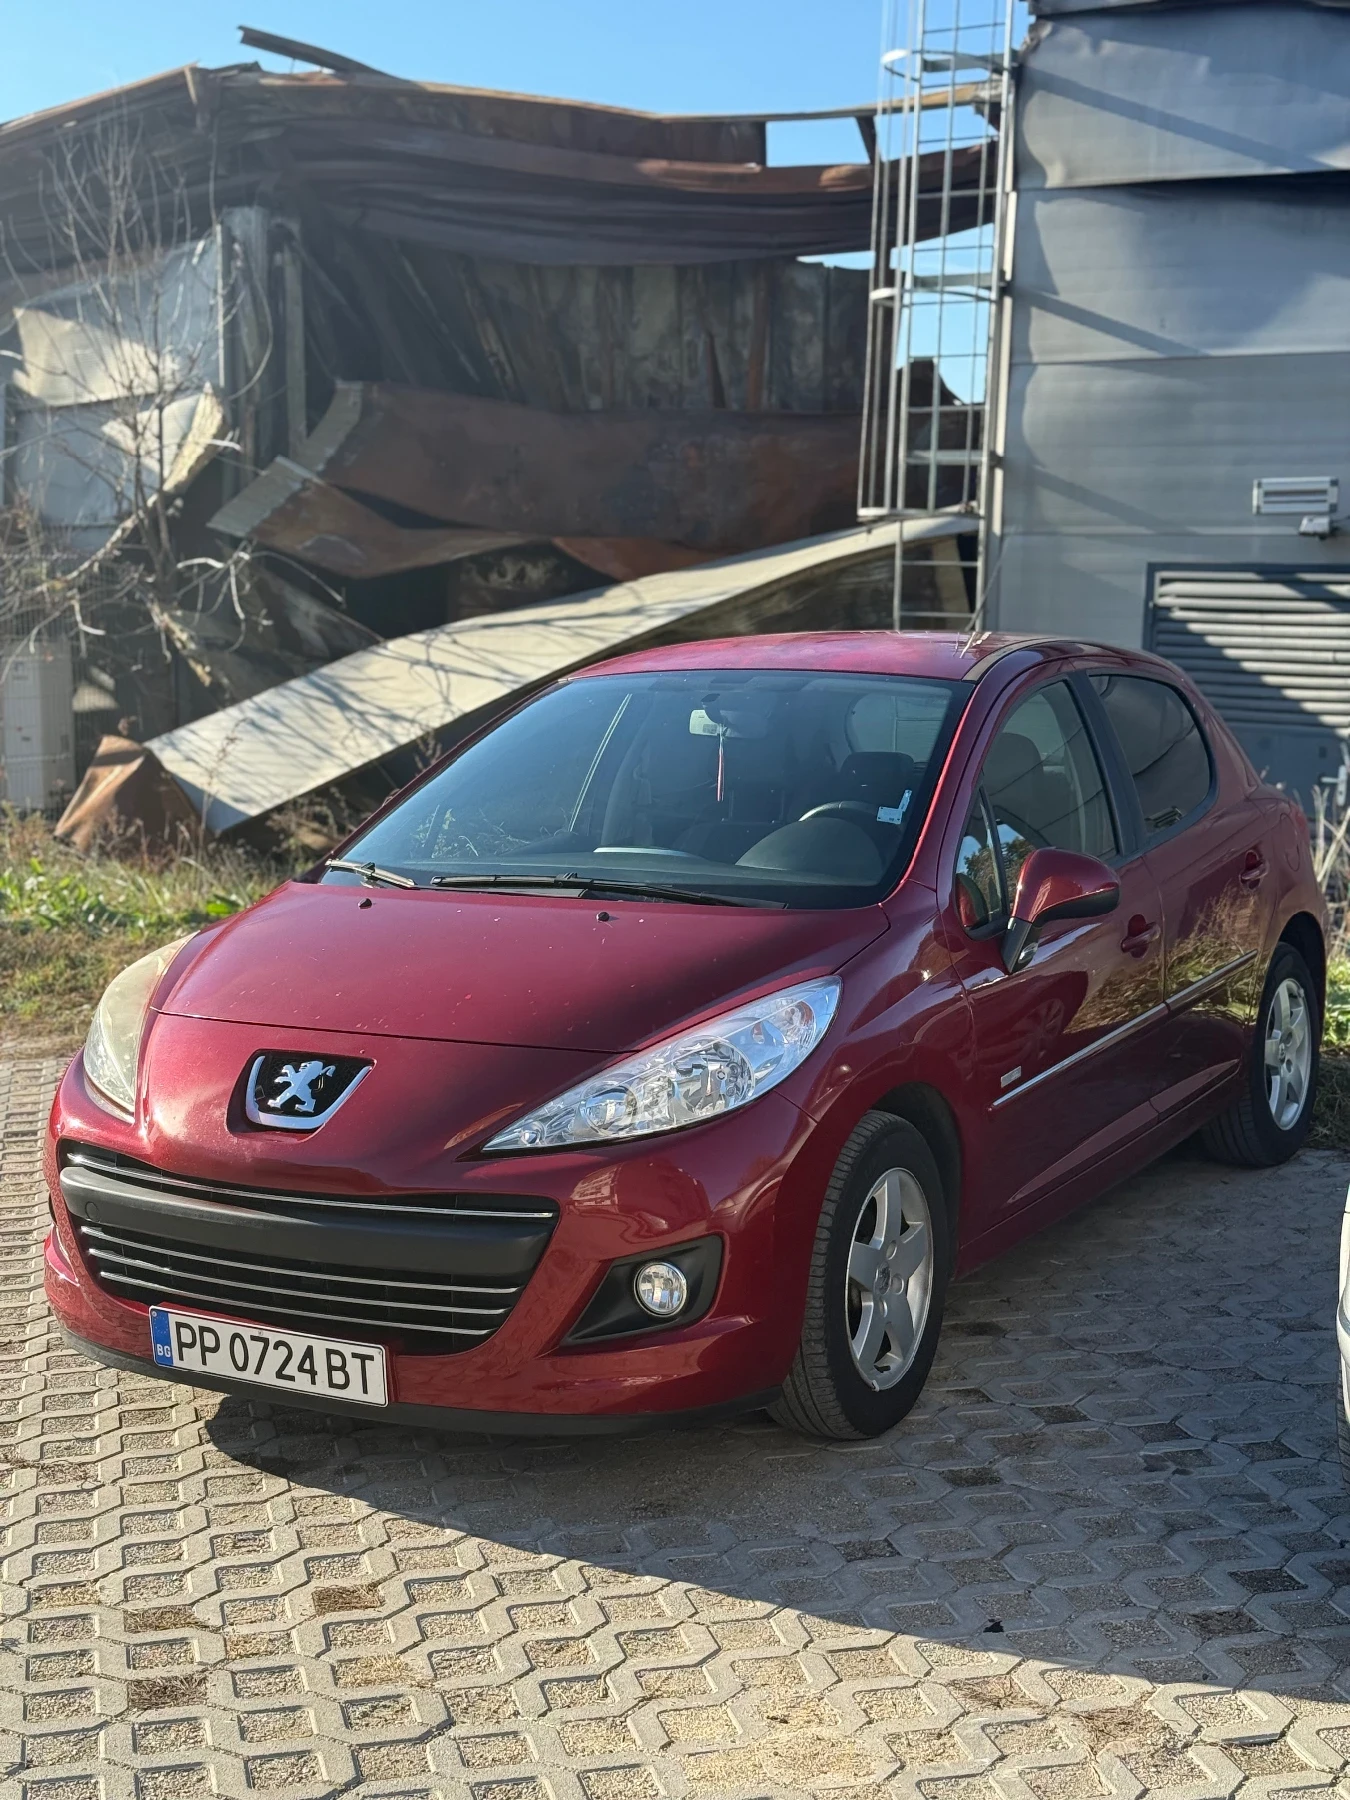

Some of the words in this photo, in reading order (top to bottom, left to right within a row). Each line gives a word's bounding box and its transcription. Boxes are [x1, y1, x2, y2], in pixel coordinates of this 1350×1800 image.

[156, 1343, 171, 1358] BG
[175, 1321, 221, 1366] PP
[229, 1332, 318, 1386] 0724
[325, 1347, 375, 1395] BT
